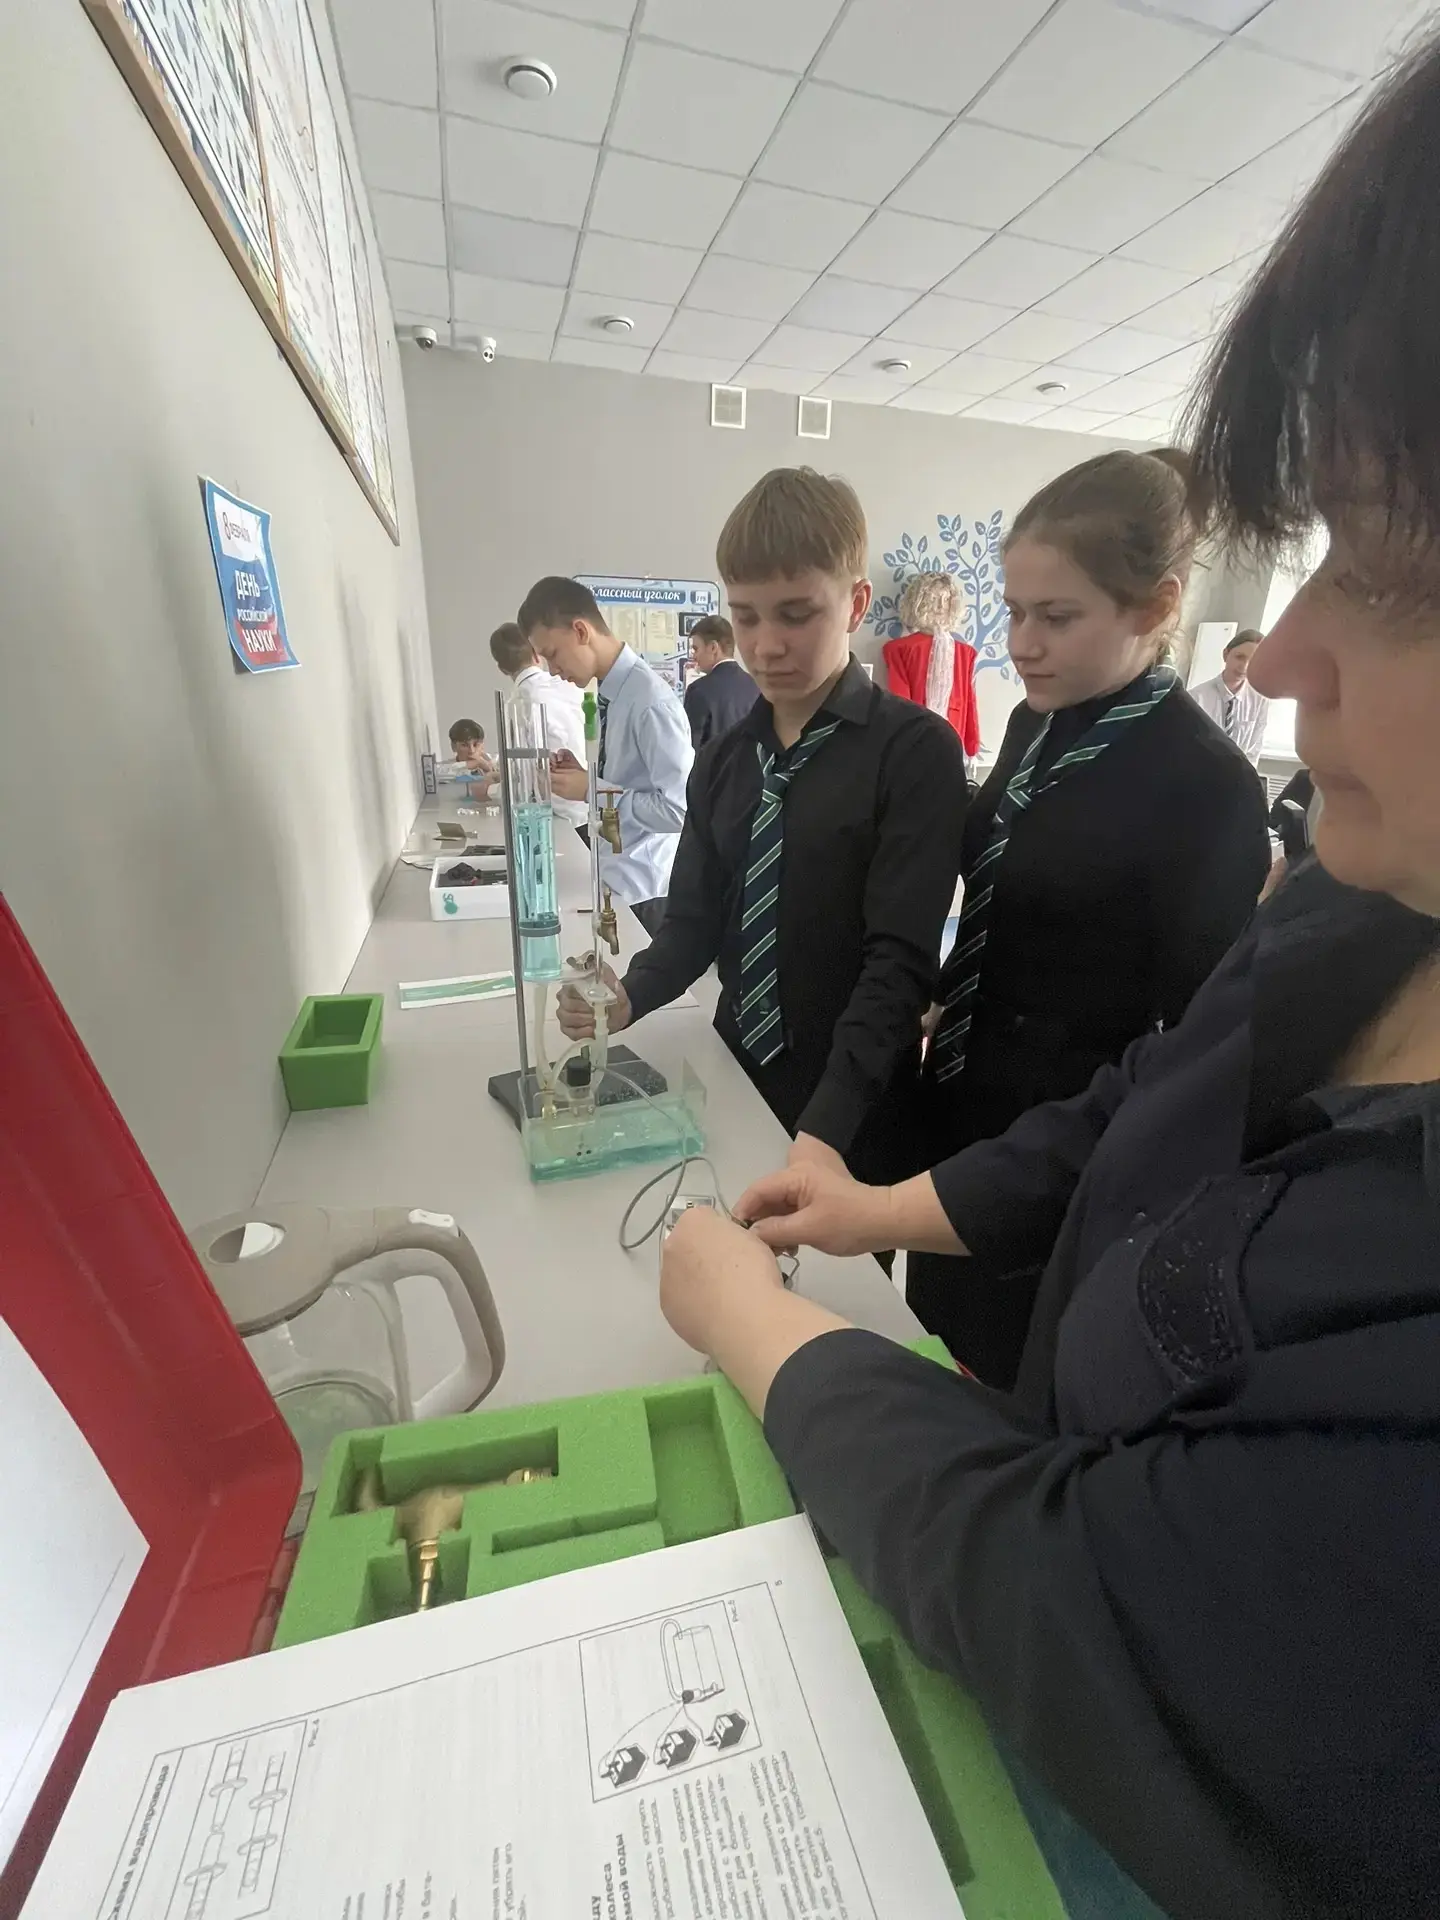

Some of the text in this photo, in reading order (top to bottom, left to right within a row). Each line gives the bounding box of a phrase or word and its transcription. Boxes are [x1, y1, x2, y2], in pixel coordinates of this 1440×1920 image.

[222, 512, 231, 540] 8
[235, 570, 261, 601] ДЕНЬ
[644, 590, 681, 603] уголок
[242, 629, 277, 653] НАУКИ
[616, 1834, 627, 1876] воды
